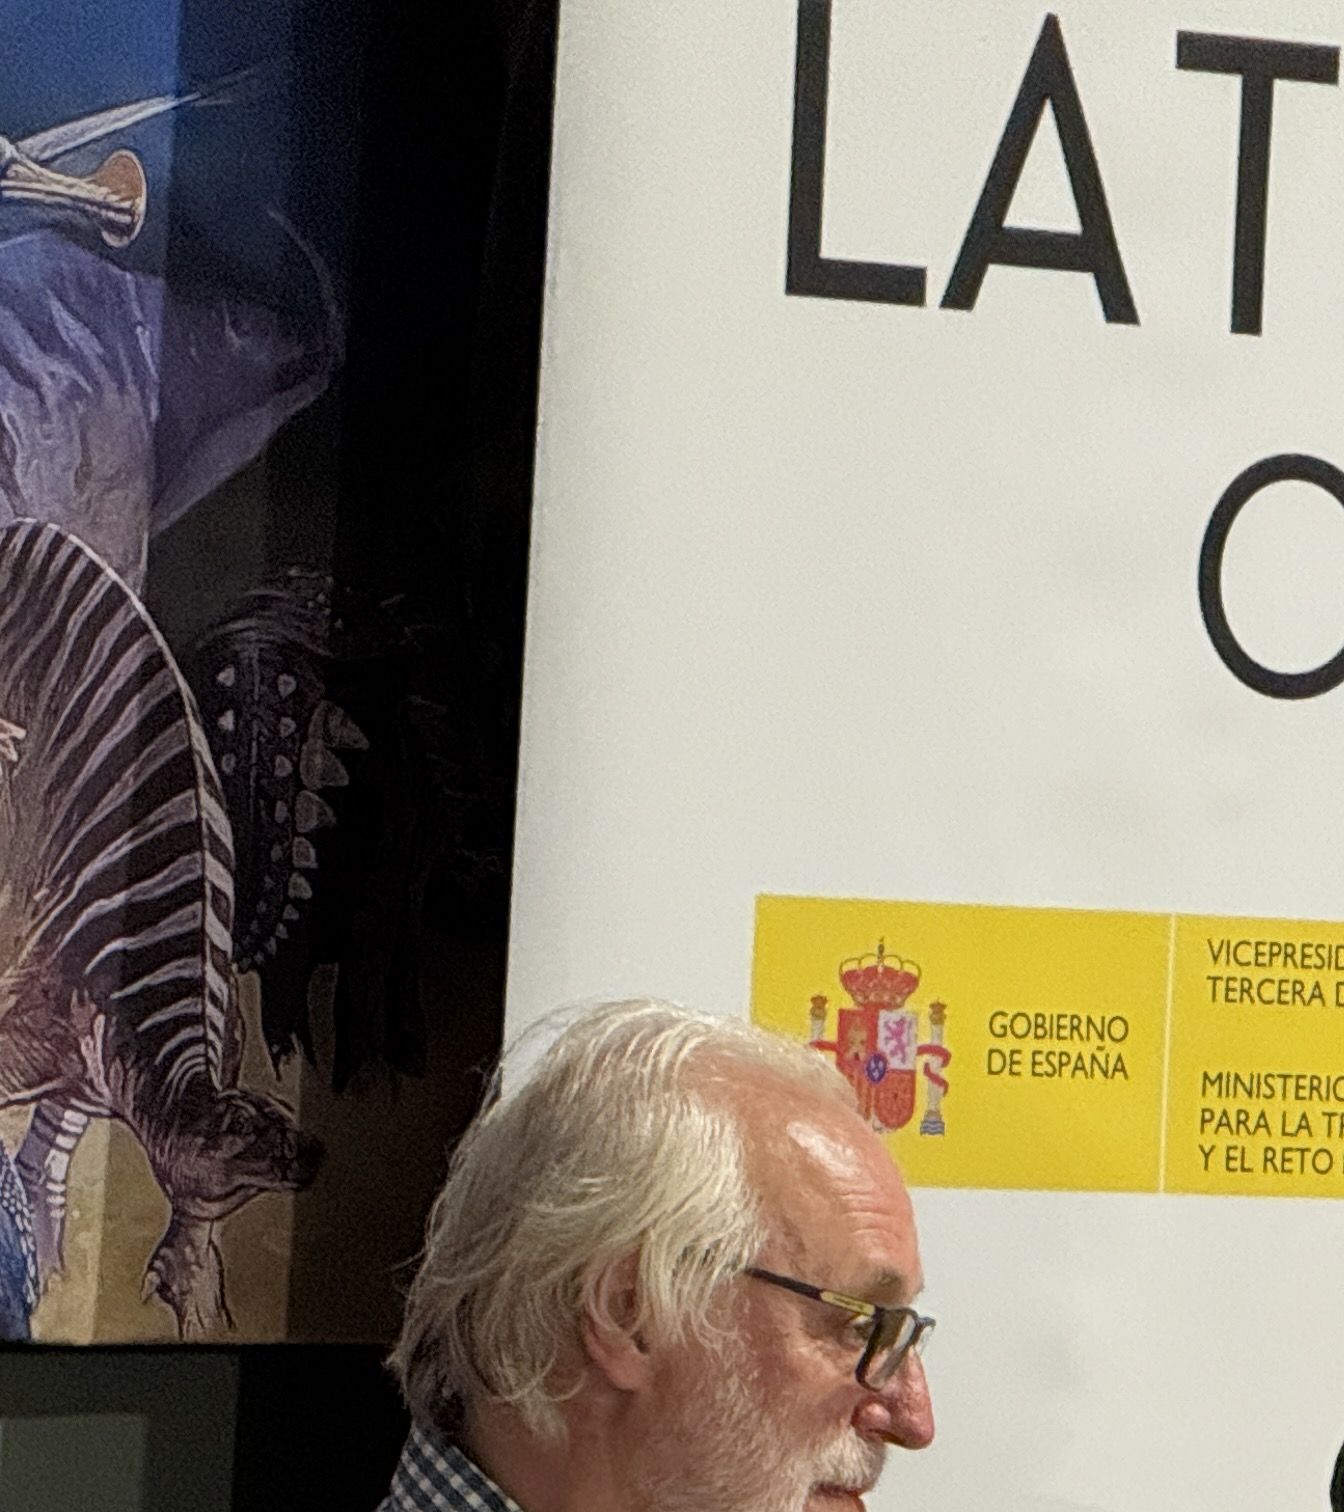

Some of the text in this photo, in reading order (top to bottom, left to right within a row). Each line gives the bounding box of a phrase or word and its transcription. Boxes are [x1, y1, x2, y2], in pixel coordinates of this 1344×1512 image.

[785, 0, 1139, 325] LA
[1206, 975, 1326, 1007] TERCERA
[988, 1010, 1130, 1043] GOBIERNO
[987, 1045, 1129, 1080] DE ESPAÑA
[1200, 1108, 1272, 1138] PARA
[1281, 1110, 1312, 1138] LA
[1198, 1144, 1216, 1172] Y
[1225, 1145, 1254, 1173] EL
[1263, 1146, 1334, 1175] RETO
